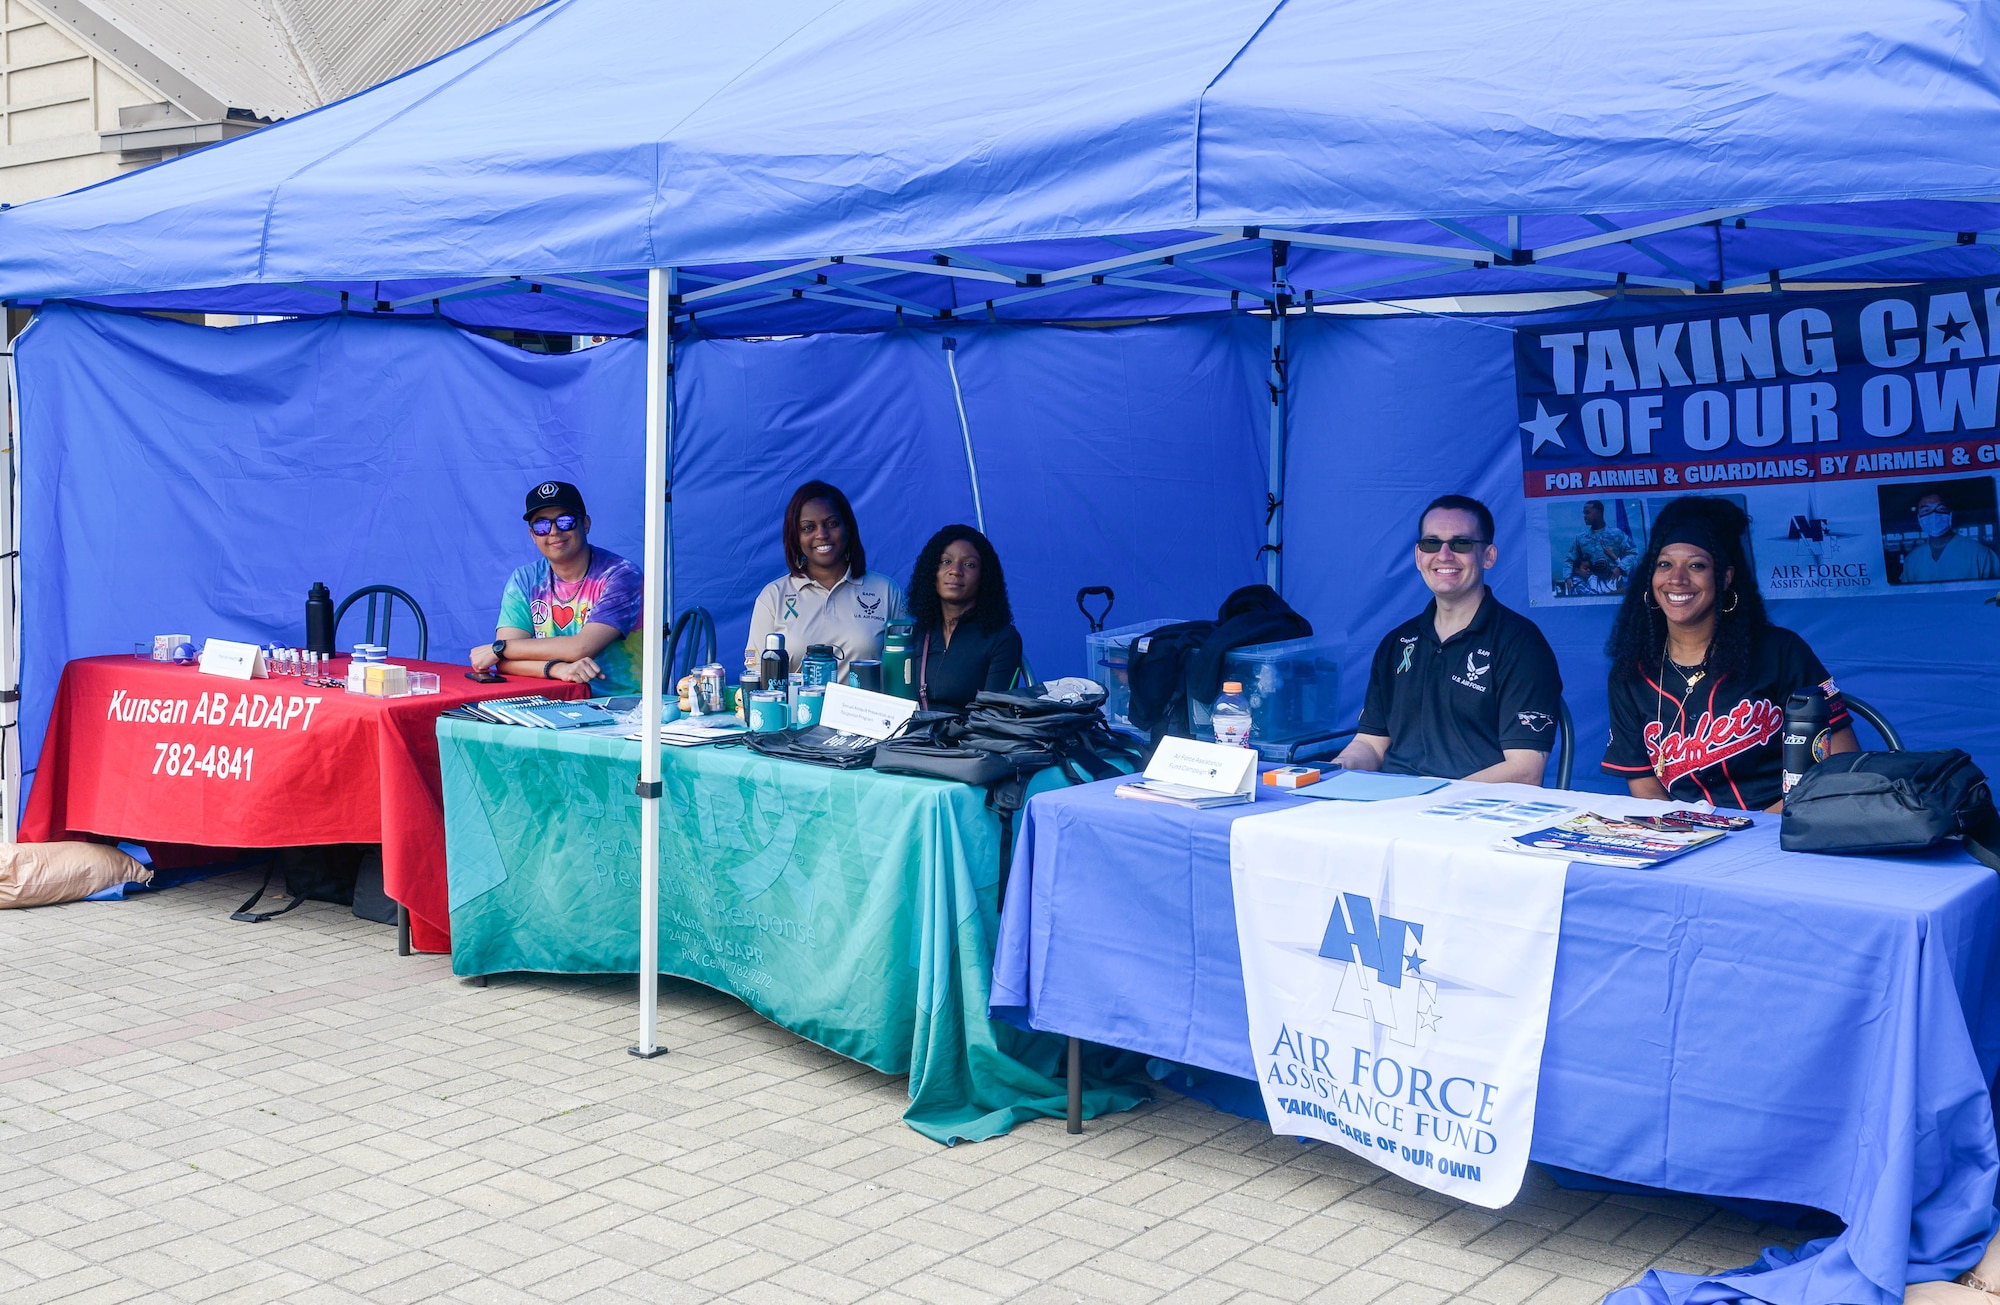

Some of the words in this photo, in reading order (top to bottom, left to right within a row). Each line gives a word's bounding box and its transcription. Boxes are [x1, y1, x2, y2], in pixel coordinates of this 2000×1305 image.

[1540, 308, 1838, 395] TAKING
[1581, 395, 1663, 457] OF
[1683, 381, 1838, 451] OUR
[1545, 472, 1583, 491] FOR
[1588, 469, 1658, 488] AIRMEN
[1664, 467, 1679, 485] &
[1685, 458, 1815, 484] GUARDIANS,
[1820, 456, 1849, 475] BY
[1855, 449, 1945, 473] AIRMEN
[1952, 446, 1970, 466] &
[1770, 577, 1834, 588] ASSISTANCE
[1837, 577, 1871, 587] FUND
[1771, 565, 1801, 579] AIR
[1808, 563, 1869, 578] FORCE
[107, 690, 188, 723] Kunsan
[191, 691, 230, 726] AB
[230, 693, 322, 731] ADAPT
[151, 742, 254, 781] 782-4841
[714, 898, 817, 949] Response
[725, 938, 765, 965] SAPR
[1268, 1022, 1335, 1079] AIR
[1351, 1046, 1499, 1125] FORCE
[1267, 1061, 1404, 1132] ASSISTANCE
[1416, 1112, 1497, 1156] FUND
[1277, 1096, 1338, 1128] TAKING
[1338, 1122, 1372, 1148] CARE
[1377, 1136, 1397, 1154] OF
[1401, 1145, 1434, 1170] OUR
[1437, 1157, 1482, 1183] OWN
